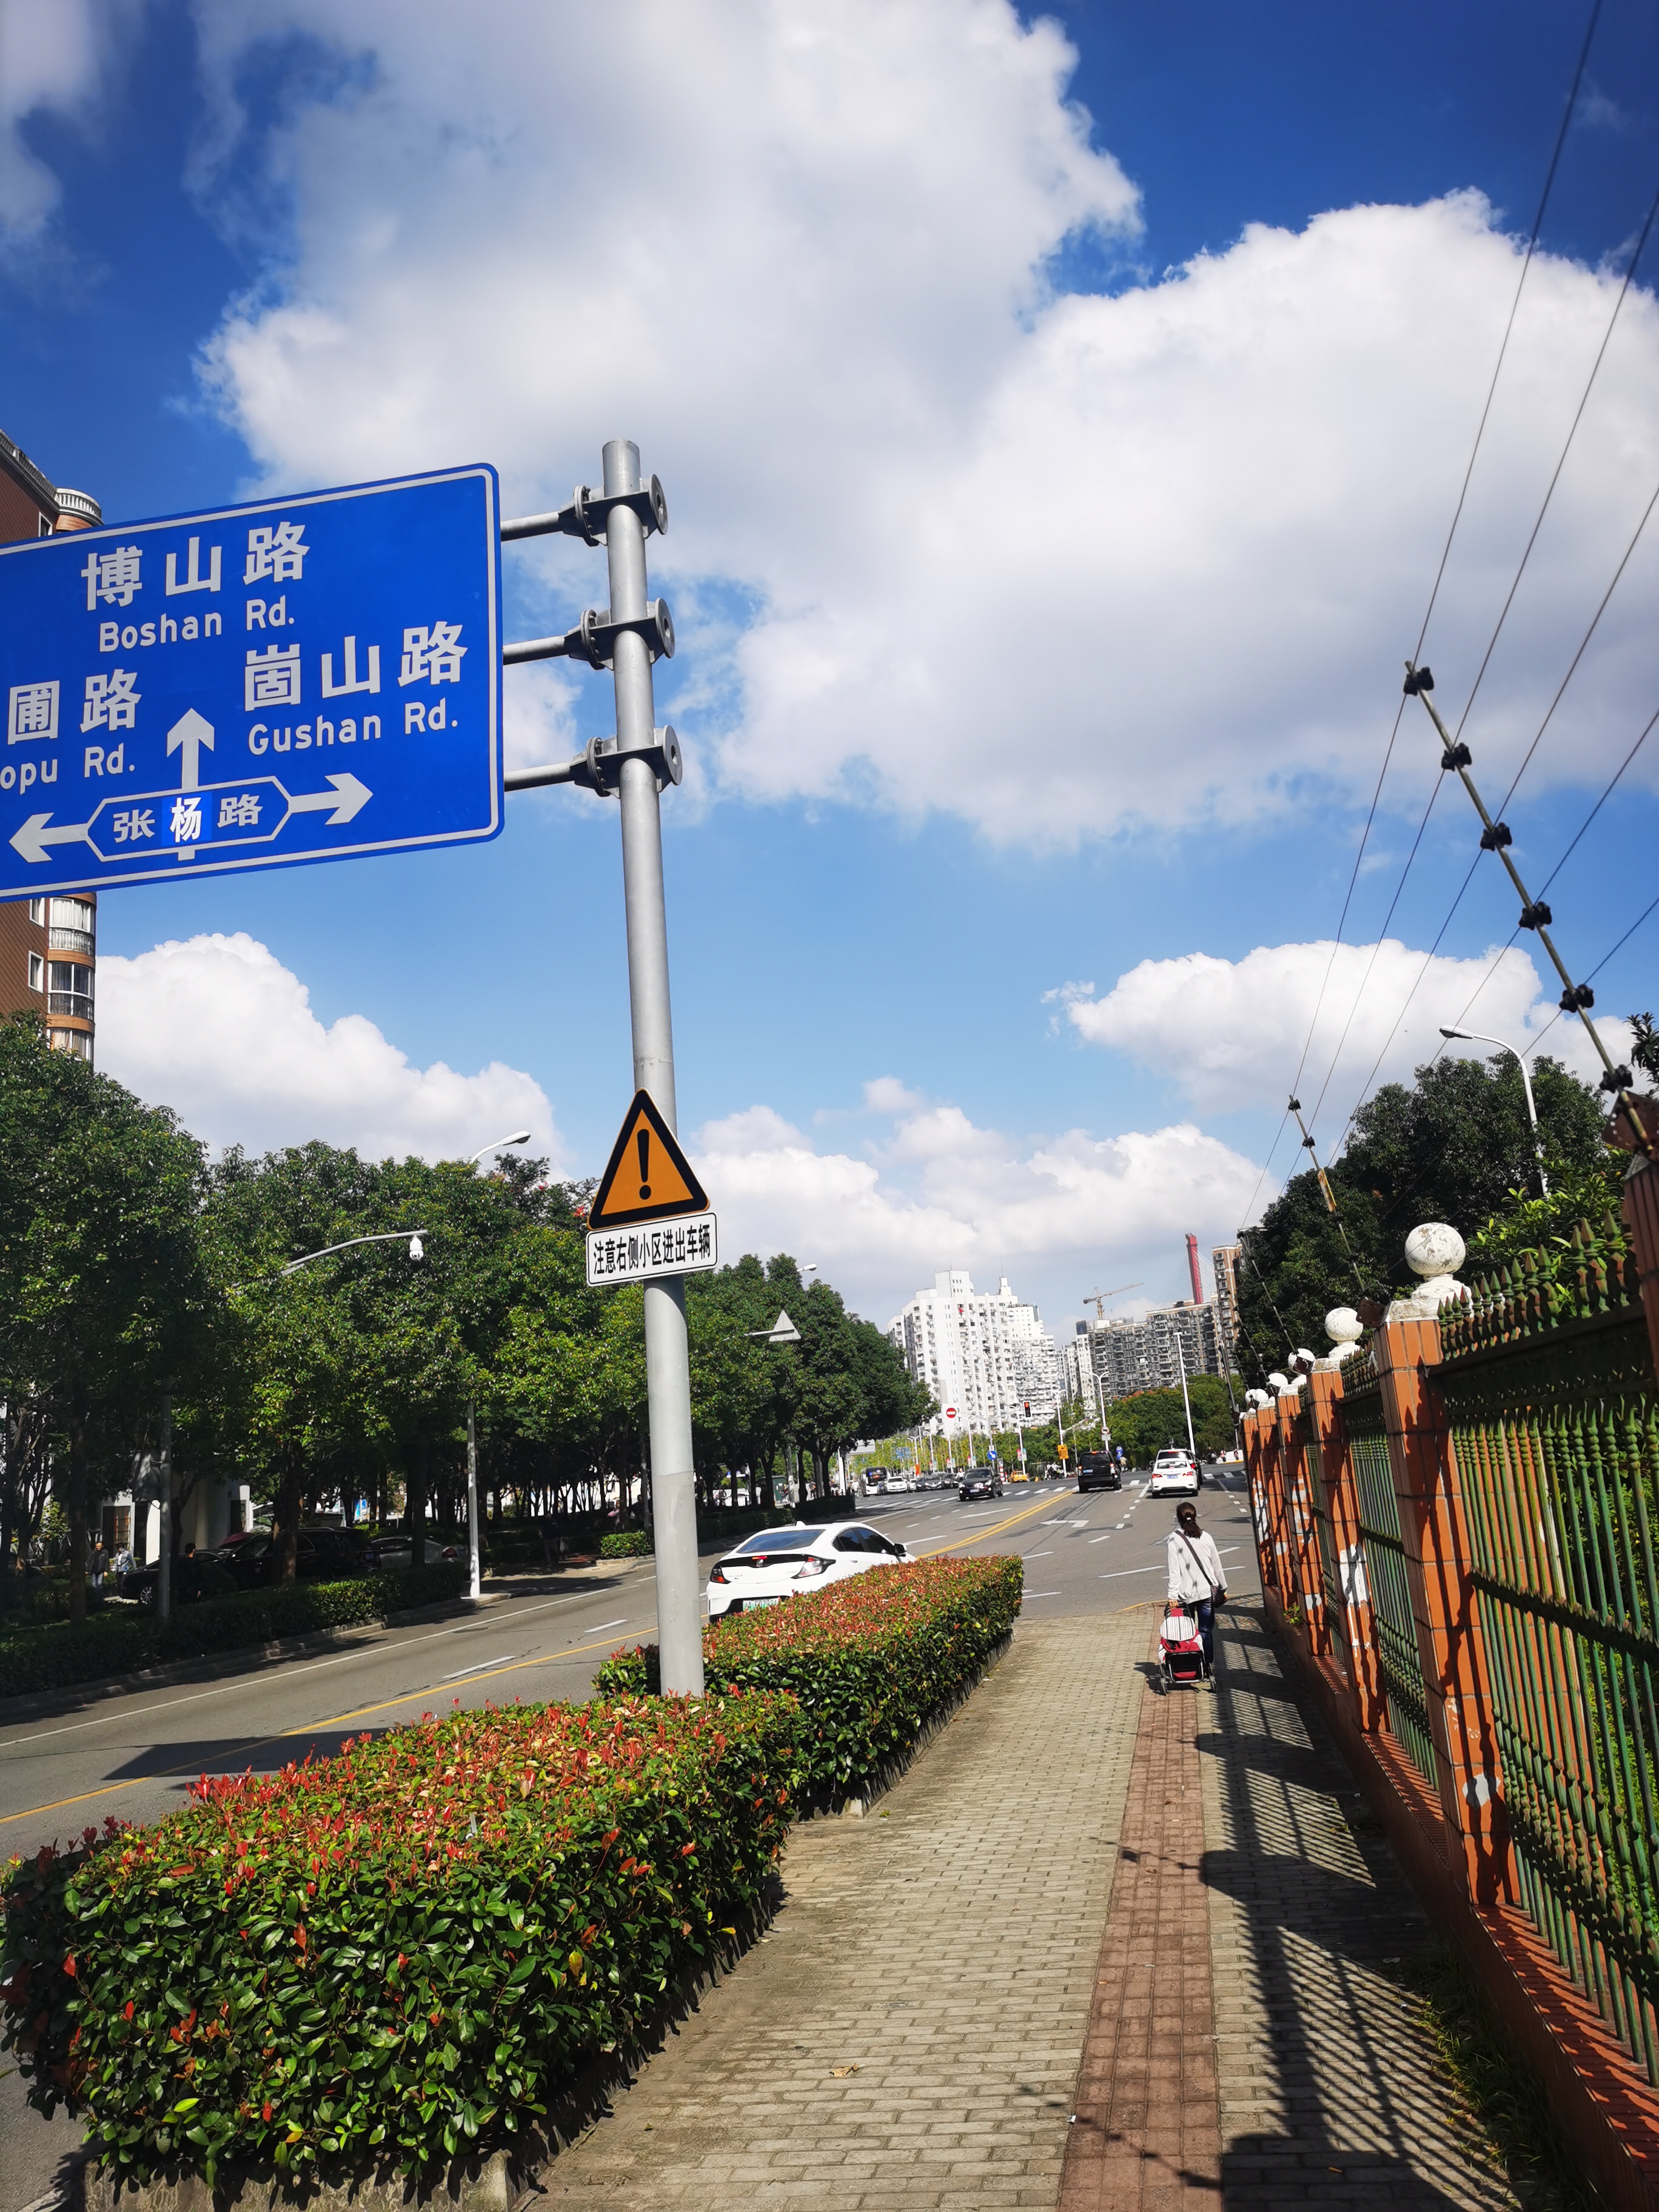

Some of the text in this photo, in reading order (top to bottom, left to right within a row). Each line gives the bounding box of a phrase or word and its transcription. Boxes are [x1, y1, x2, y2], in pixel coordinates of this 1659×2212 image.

[81, 521, 310, 611] 博山路
[99, 595, 295, 652] Boshan Rd.
[244, 621, 468, 711] 崮山路
[7, 669, 142, 745] 圃路
[248, 698, 458, 756] Gushan Rd.
[84, 743, 135, 778] Rd.
[113, 793, 264, 842] 张杨路
[593, 1223, 710, 1275] 注意右侧小区进出车辆
